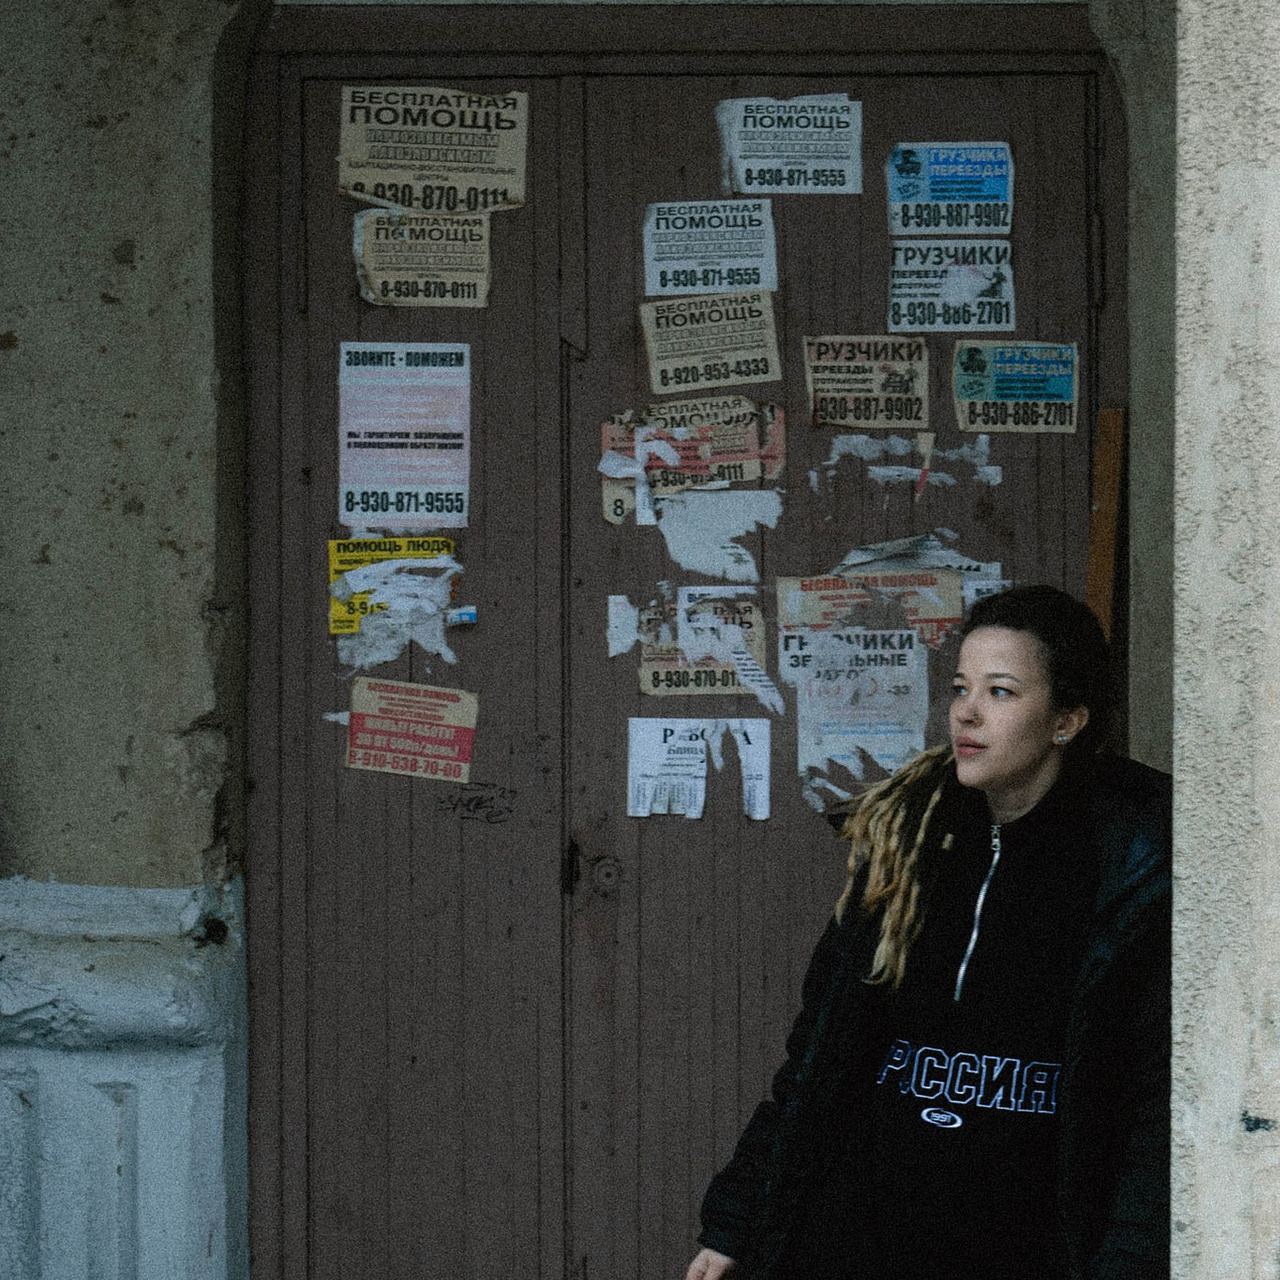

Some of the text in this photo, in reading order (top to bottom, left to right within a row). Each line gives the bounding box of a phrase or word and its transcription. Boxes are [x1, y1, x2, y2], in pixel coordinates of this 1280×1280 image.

[351, 91, 517, 110] БЕСПЛАТНАЯ
[745, 104, 849, 114] БЕСПЛАТНАЯ
[350, 106, 517, 131] ПОМОЩЬ
[743, 115, 849, 130] ПОМОЩЬ
[930, 148, 1006, 163] ГРУЗЧИКИ
[745, 168, 846, 186] 8-930-871-9555
[930, 164, 1007, 178] ПЕРЕЕЗДЫ
[352, 182, 509, 210] 930-870-0111
[657, 204, 762, 216] БЕСПЛАТНАЯ
[902, 203, 1009, 228] 8-930-887-9902
[656, 216, 762, 231] ПОМОЩЬ
[892, 246, 1008, 266] ГРУЗЧИКИ
[660, 267, 761, 288] 8-930-871-9555
[381, 281, 478, 299] 8-930-870-0111
[656, 294, 761, 315] БЕСПЛАТНАЯ
[656, 306, 763, 329] ПОМОЩЬ
[808, 341, 923, 361] РУЗЧИКИ
[660, 357, 769, 387] 8-920-953-4333
[811, 365, 873, 375] ЕРЕЕЗДЫ
[646, 400, 742, 417] ЕСПЛАТНАЯ
[813, 396, 923, 422] 930-887-9902
[968, 401, 1074, 426] 8-930-886-2701
[345, 490, 465, 514] 8-930-871-9555
[337, 542, 402, 554] ПОМОЩЬ
[801, 576, 880, 592] БЕСПЛААЯ
[652, 670, 742, 689] 8-930-870-01
[876, 1037, 1063, 1116] РССИЯ
